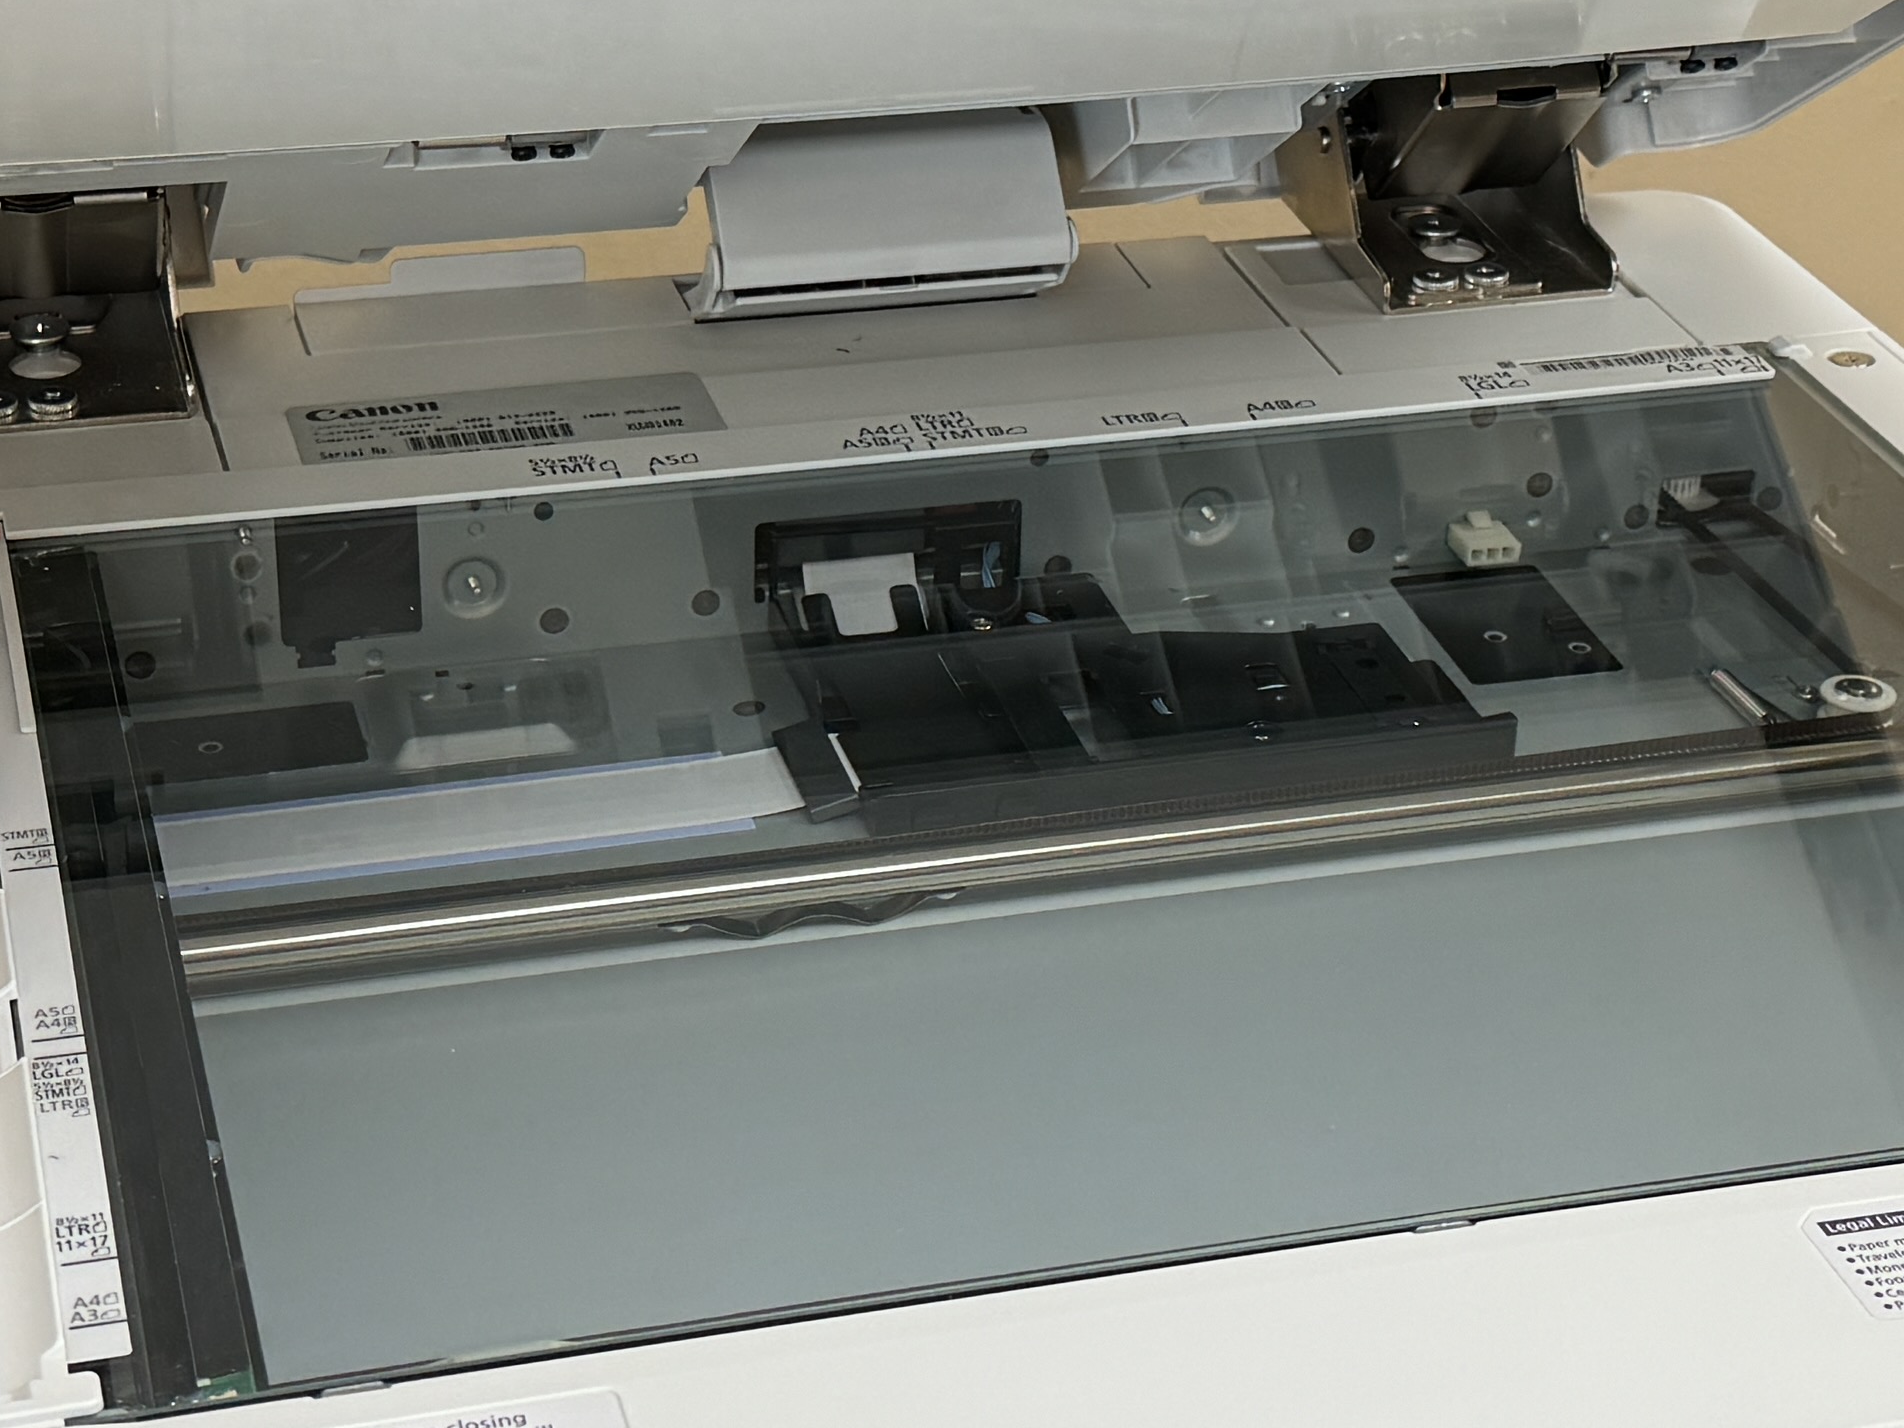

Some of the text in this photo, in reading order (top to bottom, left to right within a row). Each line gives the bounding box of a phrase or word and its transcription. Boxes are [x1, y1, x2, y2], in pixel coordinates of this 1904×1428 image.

[306, 401, 439, 421] Canon
[35, 1007, 60, 1018] A5
[33, 1068, 64, 1080] LGL
[55, 1224, 90, 1238] LTR
[1825, 1218, 1874, 1235] Legal
[1848, 1240, 1890, 1252] Paper
[73, 1295, 100, 1309] A4
[71, 1309, 98, 1323] A3
